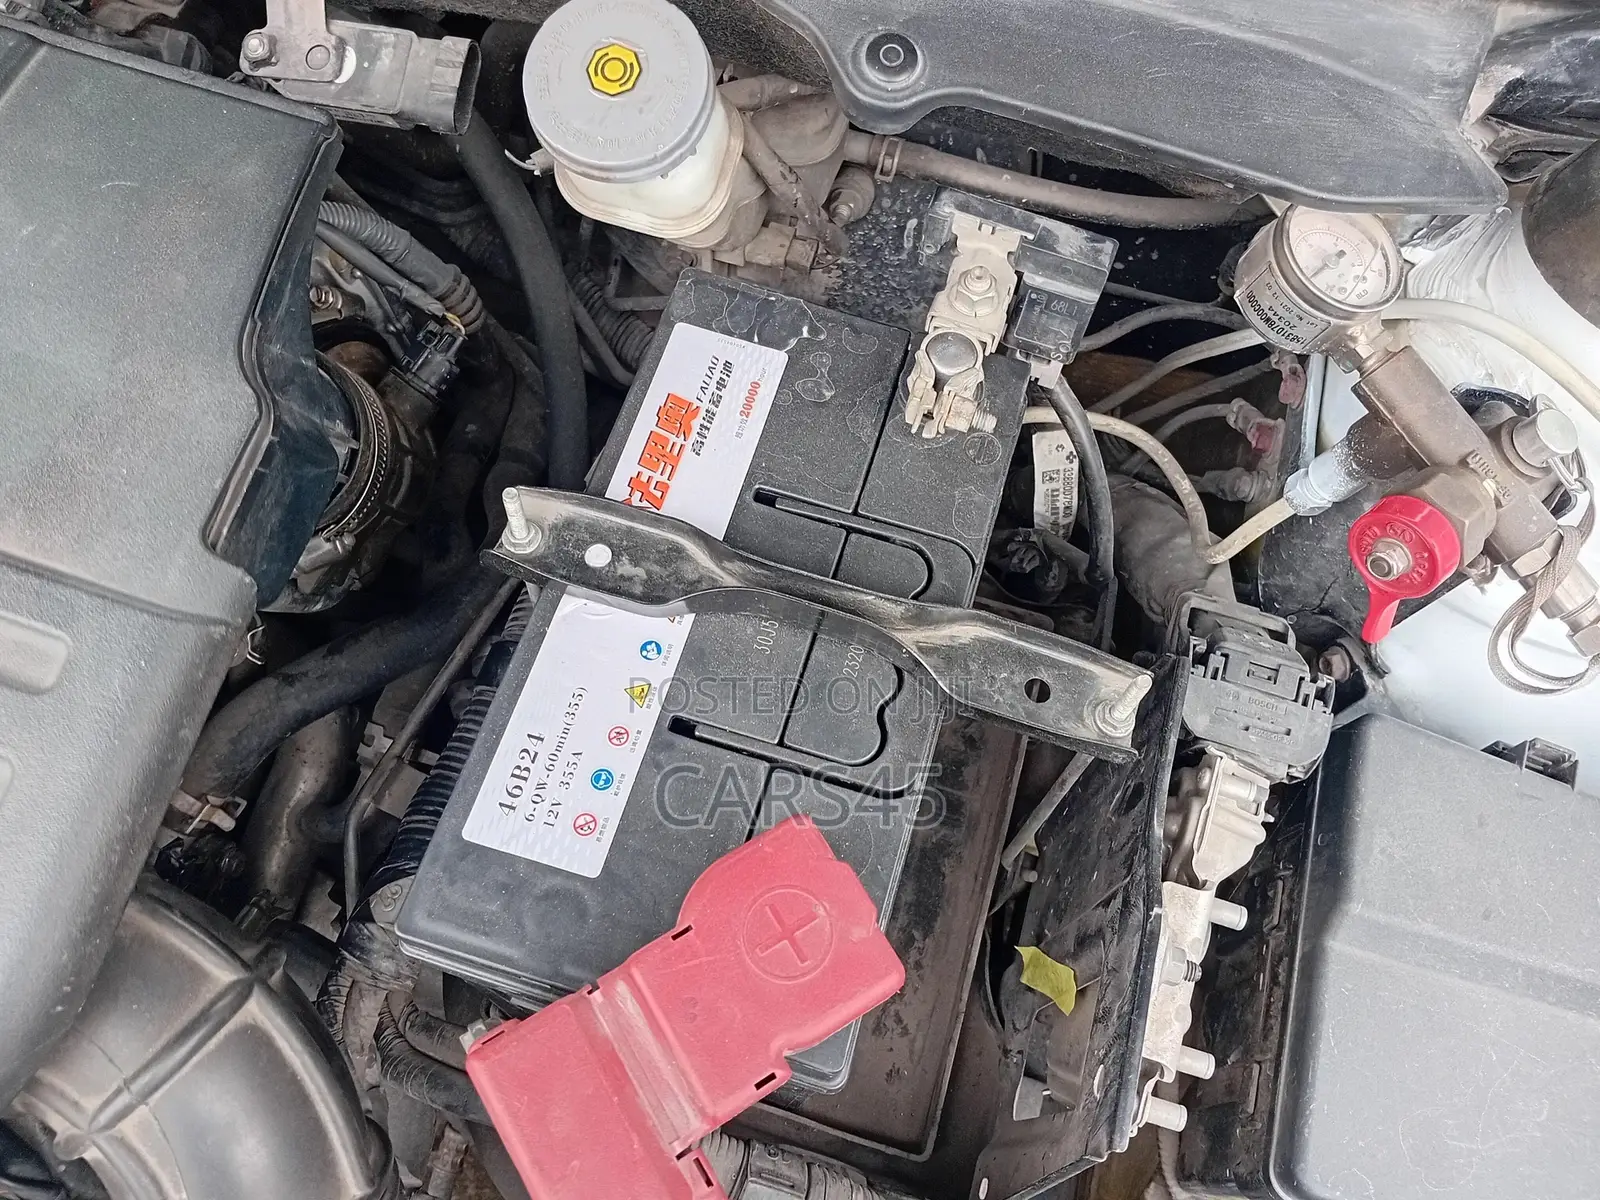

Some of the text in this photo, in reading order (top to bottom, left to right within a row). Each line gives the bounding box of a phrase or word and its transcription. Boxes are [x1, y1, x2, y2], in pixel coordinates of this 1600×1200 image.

[1267, 305, 1297, 330] 20344
[696, 355, 720, 404] FALIAO
[690, 359, 735, 457] 高性能蓄电池
[754, 619, 779, 654] 30J5
[842, 645, 865, 678] 2320
[1247, 696, 1279, 712] BOSCH
[498, 731, 547, 817] 46B24
[523, 686, 589, 823] 6-QW-60min(355)
[543, 749, 584, 828] 12V 355A
